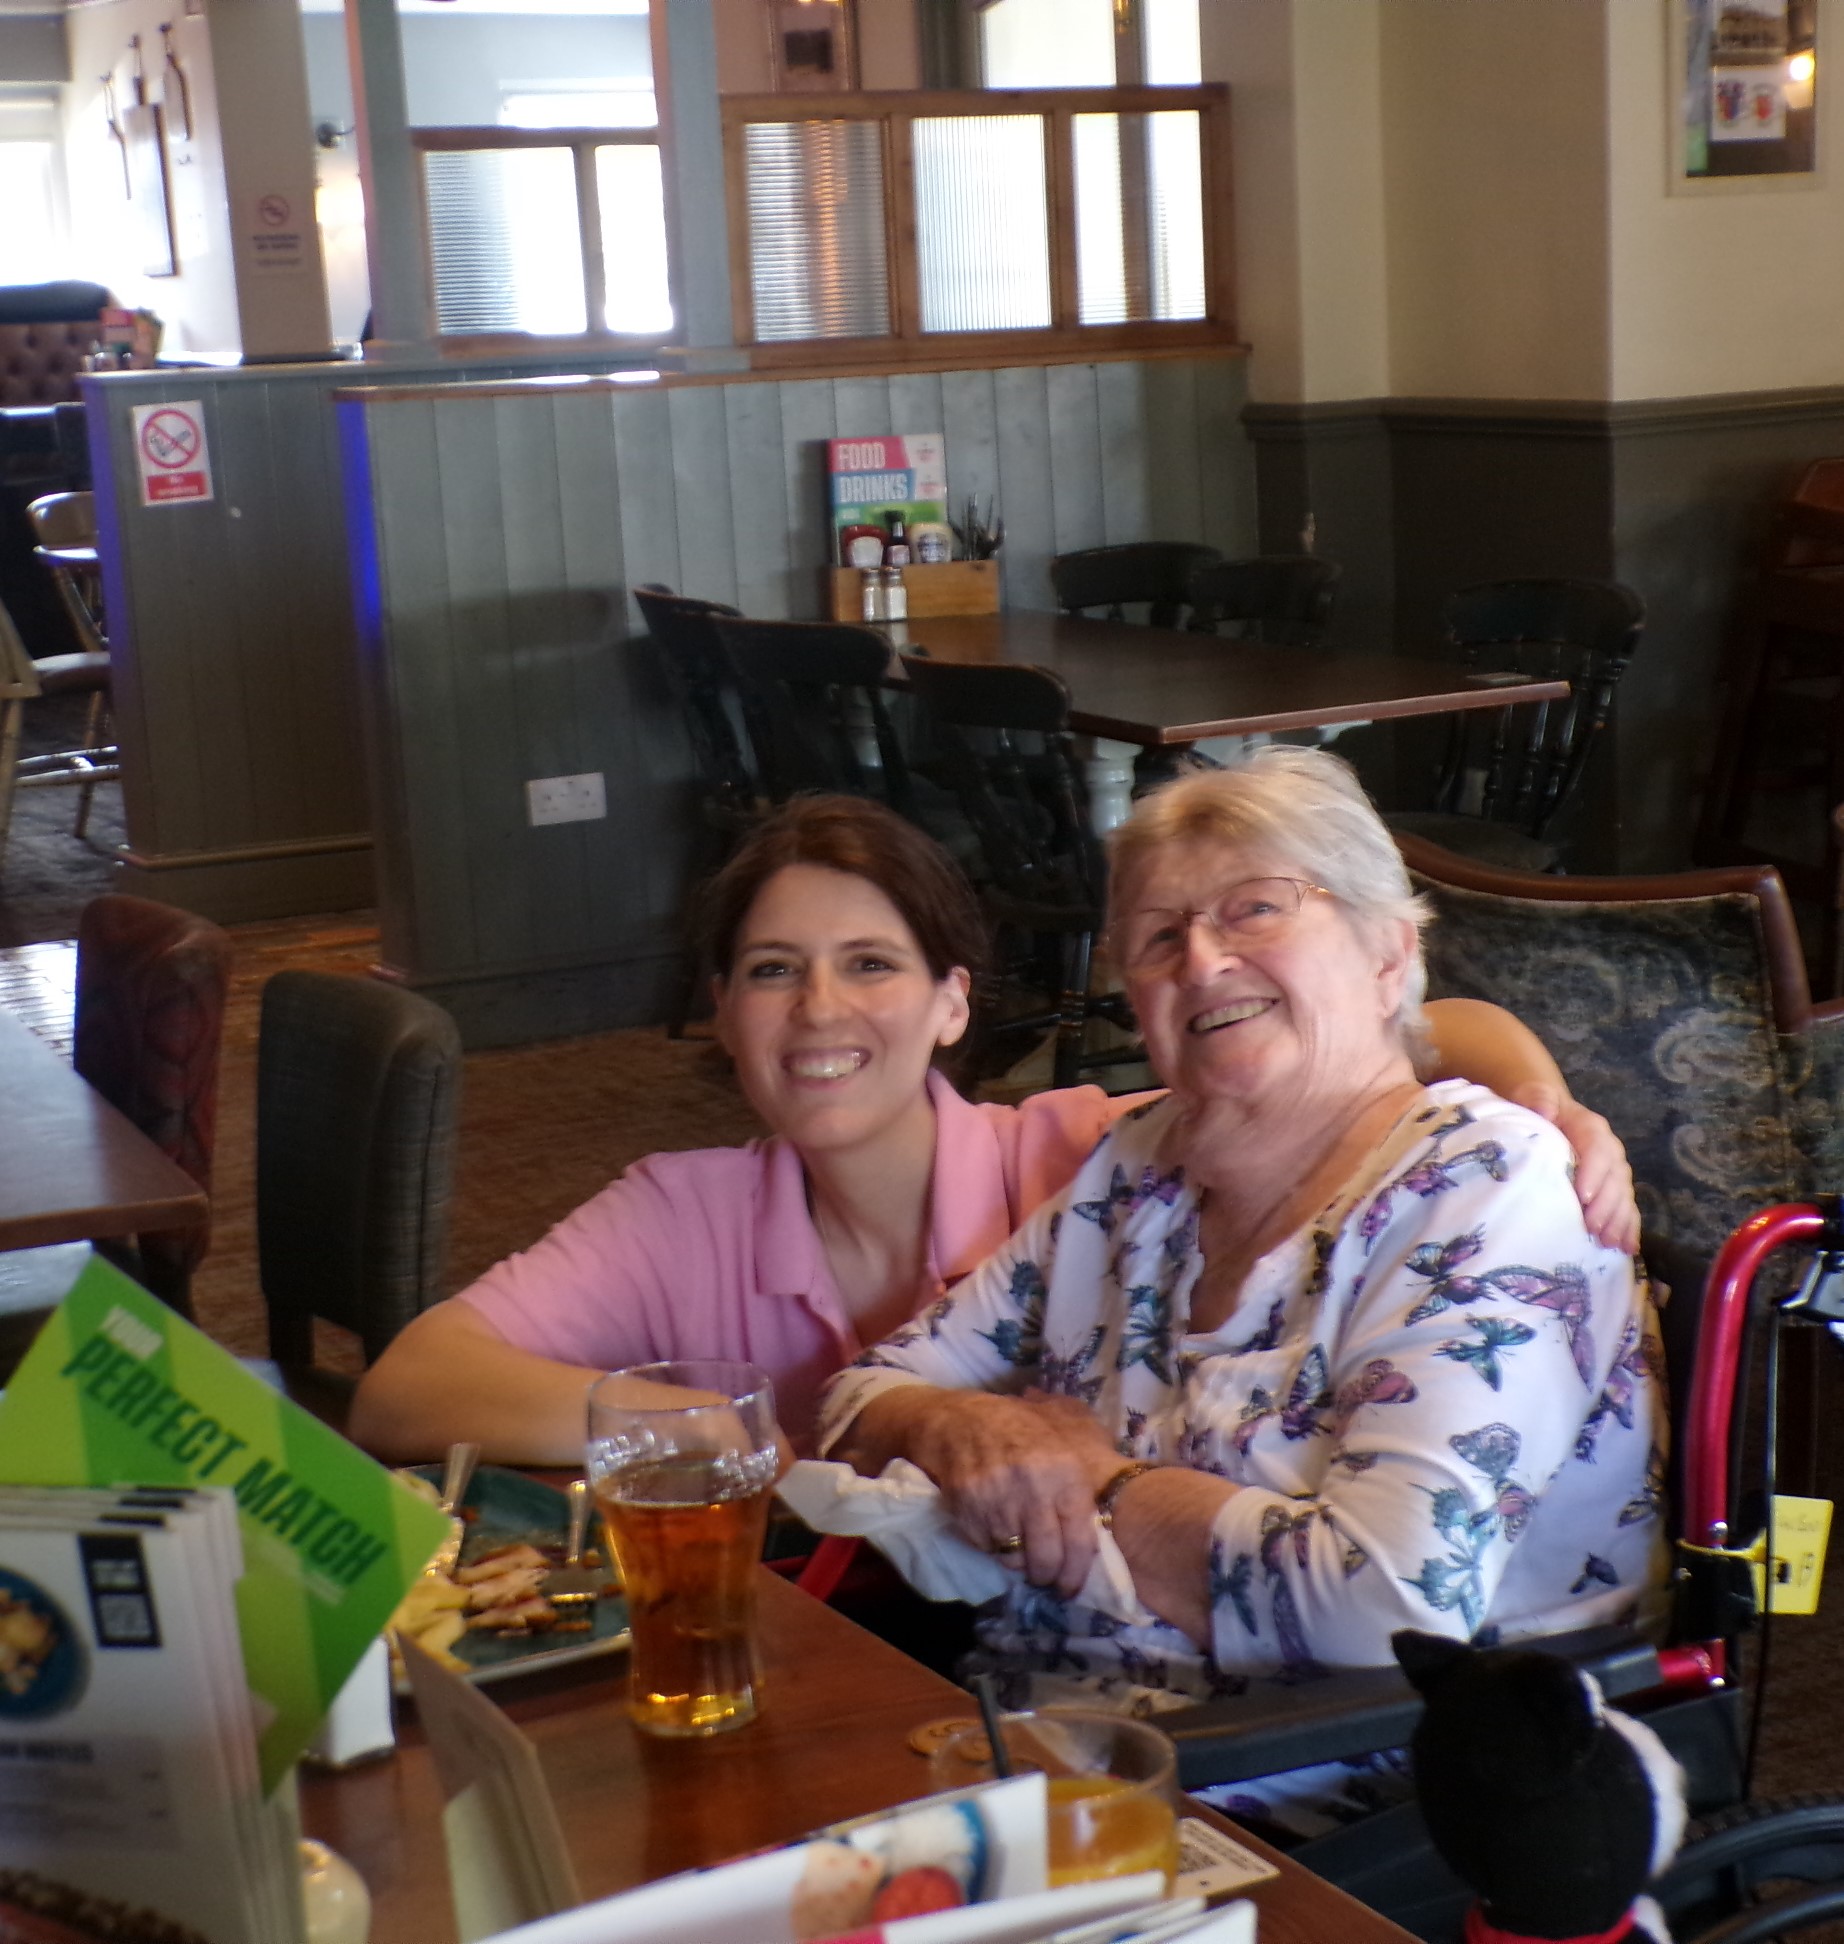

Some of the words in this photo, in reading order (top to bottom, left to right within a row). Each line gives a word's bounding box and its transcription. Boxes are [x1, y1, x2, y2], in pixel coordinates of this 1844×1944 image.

[838, 441, 886, 471] FOOD
[838, 473, 908, 503] DRINKS
[61, 1333, 248, 1479] PERFECT
[233, 1456, 388, 1586] MATCH
